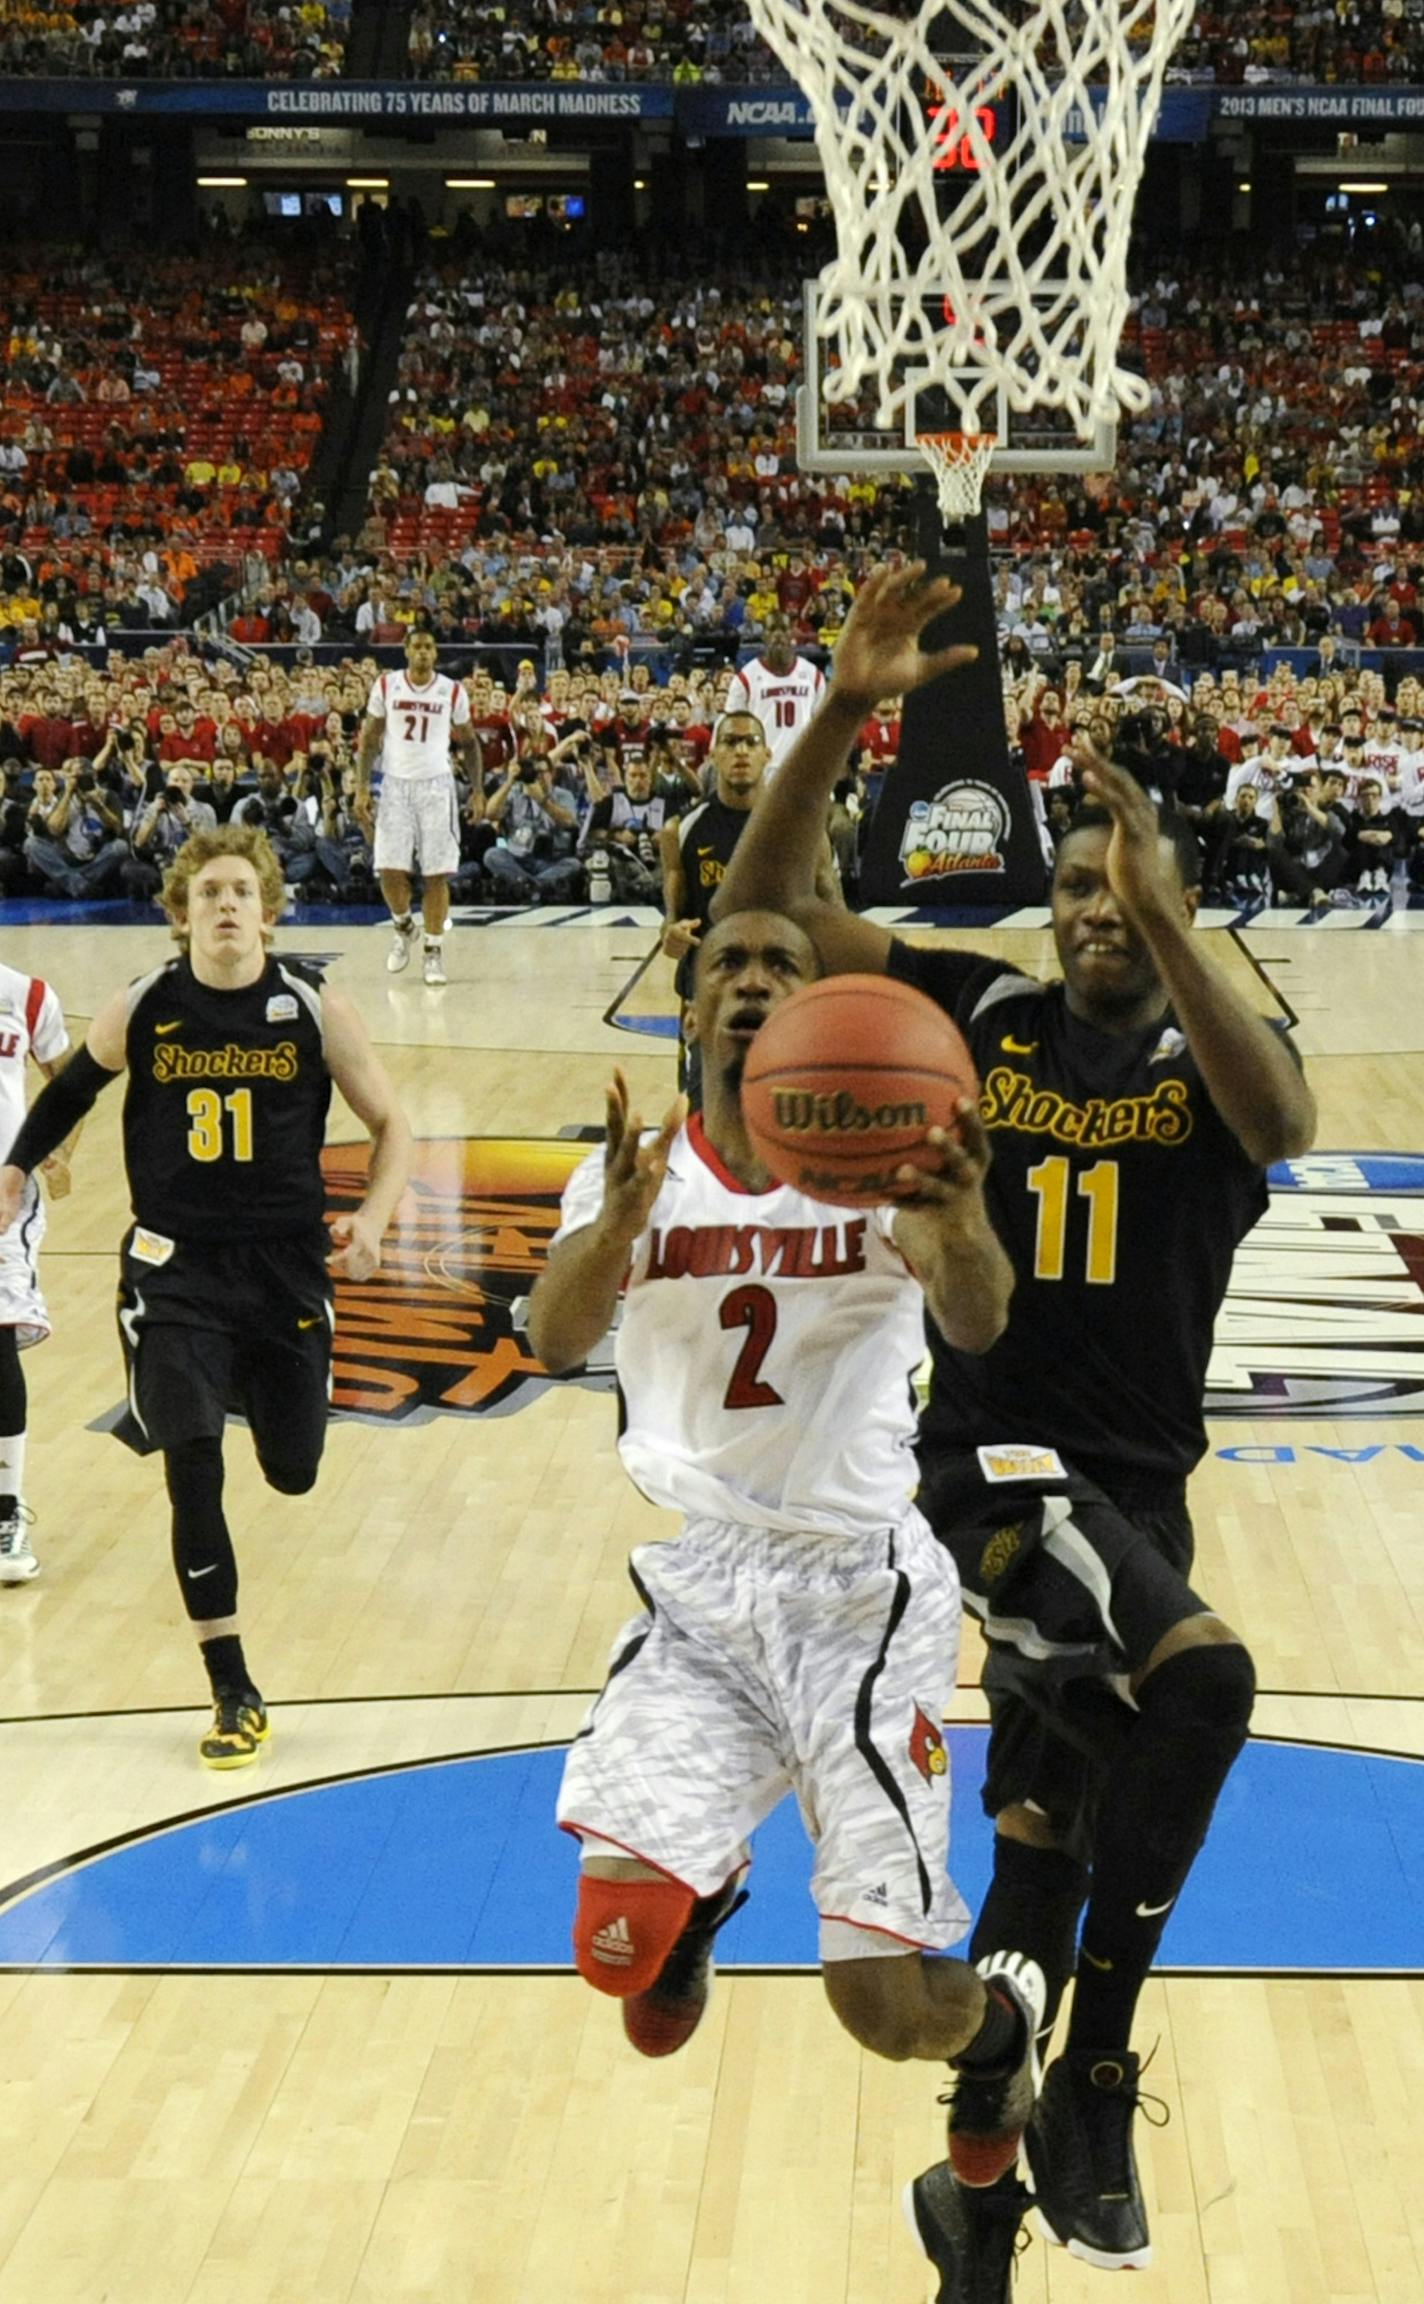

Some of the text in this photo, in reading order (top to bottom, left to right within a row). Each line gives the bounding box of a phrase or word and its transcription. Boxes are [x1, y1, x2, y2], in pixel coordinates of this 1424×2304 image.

[267, 91, 641, 115] CELEBRATING 75 YEARS OF MARCH MADNESS
[1220, 97, 1255, 115] 2013
[1258, 98, 1304, 116] MEN'S
[1307, 98, 1347, 116] NCAA
[1351, 97, 1394, 116] FINAL
[404, 715, 428, 743] 21
[776, 700, 796, 728] 10
[904, 820, 994, 854] FOUR
[928, 805, 994, 830] FINAL
[153, 1042, 297, 1083] Shockers
[186, 1087, 253, 1162] 31
[770, 1086, 928, 1132] Wilson
[979, 1066, 1193, 1146] Shockers
[1026, 1155, 1119, 1285] 11
[645, 1217, 868, 1280] LOUISVILLE
[719, 1284, 786, 1409] 2
